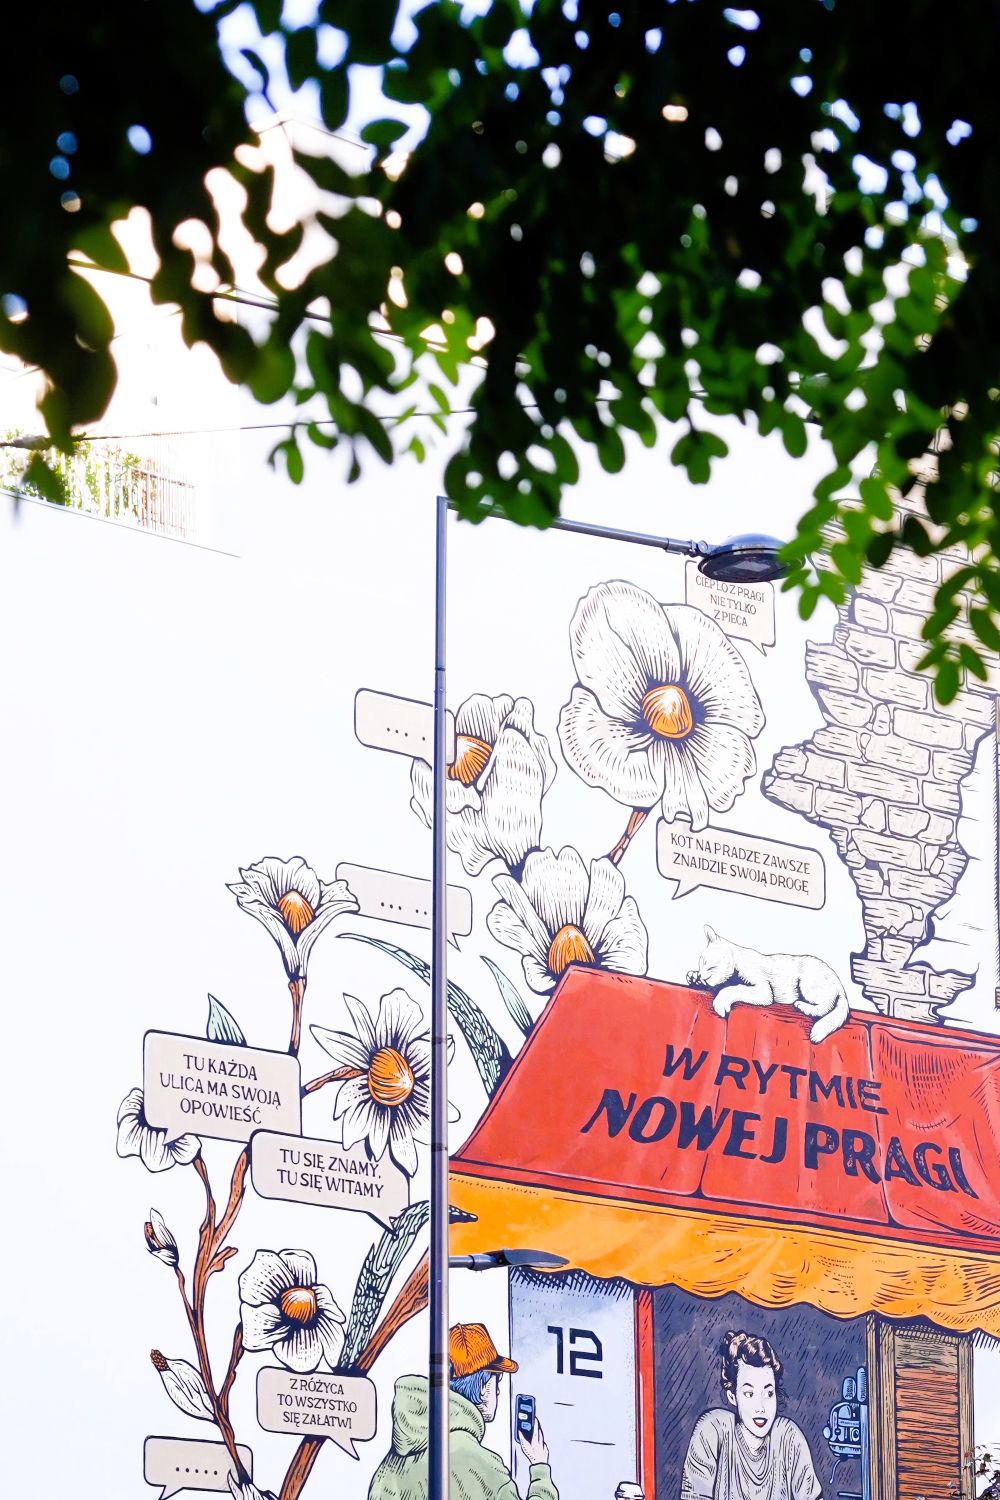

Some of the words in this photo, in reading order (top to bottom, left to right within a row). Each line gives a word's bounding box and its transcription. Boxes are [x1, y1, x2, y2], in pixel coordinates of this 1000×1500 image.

[710, 593, 726, 607] NIE
[727, 597, 757, 615] TYLKO
[729, 584, 736, 595] Z
[737, 586, 765, 603] PRAGI
[714, 609, 721, 620] Z
[721, 611, 748, 627] PIECA
[671, 832, 693, 849] KOT
[696, 838, 712, 854] NA
[714, 842, 761, 864] PRADZE
[762, 853, 811, 875] ZAWSZE
[673, 852, 728, 875] ZNAJDZIE
[730, 864, 767, 887] SWOJĄ
[770, 873, 809, 895] DROGĘ
[183, 1054, 205, 1071] TU
[208, 1059, 258, 1081] KAŻDA
[662, 1044, 709, 1081] W
[714, 1054, 889, 1115] RYTMIE
[160, 1072, 204, 1093] ULICA
[207, 1080, 228, 1097] MA
[232, 1084, 281, 1110] SWOJĄ
[180, 1098, 262, 1124] OPOWIEŚĆ
[580, 1088, 789, 1164] NOWEJ
[804, 1122, 980, 1200] PRAGI
[280, 1148, 300, 1165] TU
[303, 1152, 325, 1172] SIĘ
[277, 1169, 298, 1185] TU
[300, 1172, 323, 1192] SIĘ
[325, 1176, 384, 1198] WITAMY
[547, 1325, 603, 1379] 12
[289, 1378, 298, 1390] Z
[300, 1377, 345, 1395] RÓŻYCA
[277, 1393, 293, 1407] TO
[295, 1395, 357, 1413] WSZYSTKO
[283, 1411, 300, 1427] SIĘ
[302, 1413, 352, 1429] ZAŁATWI
